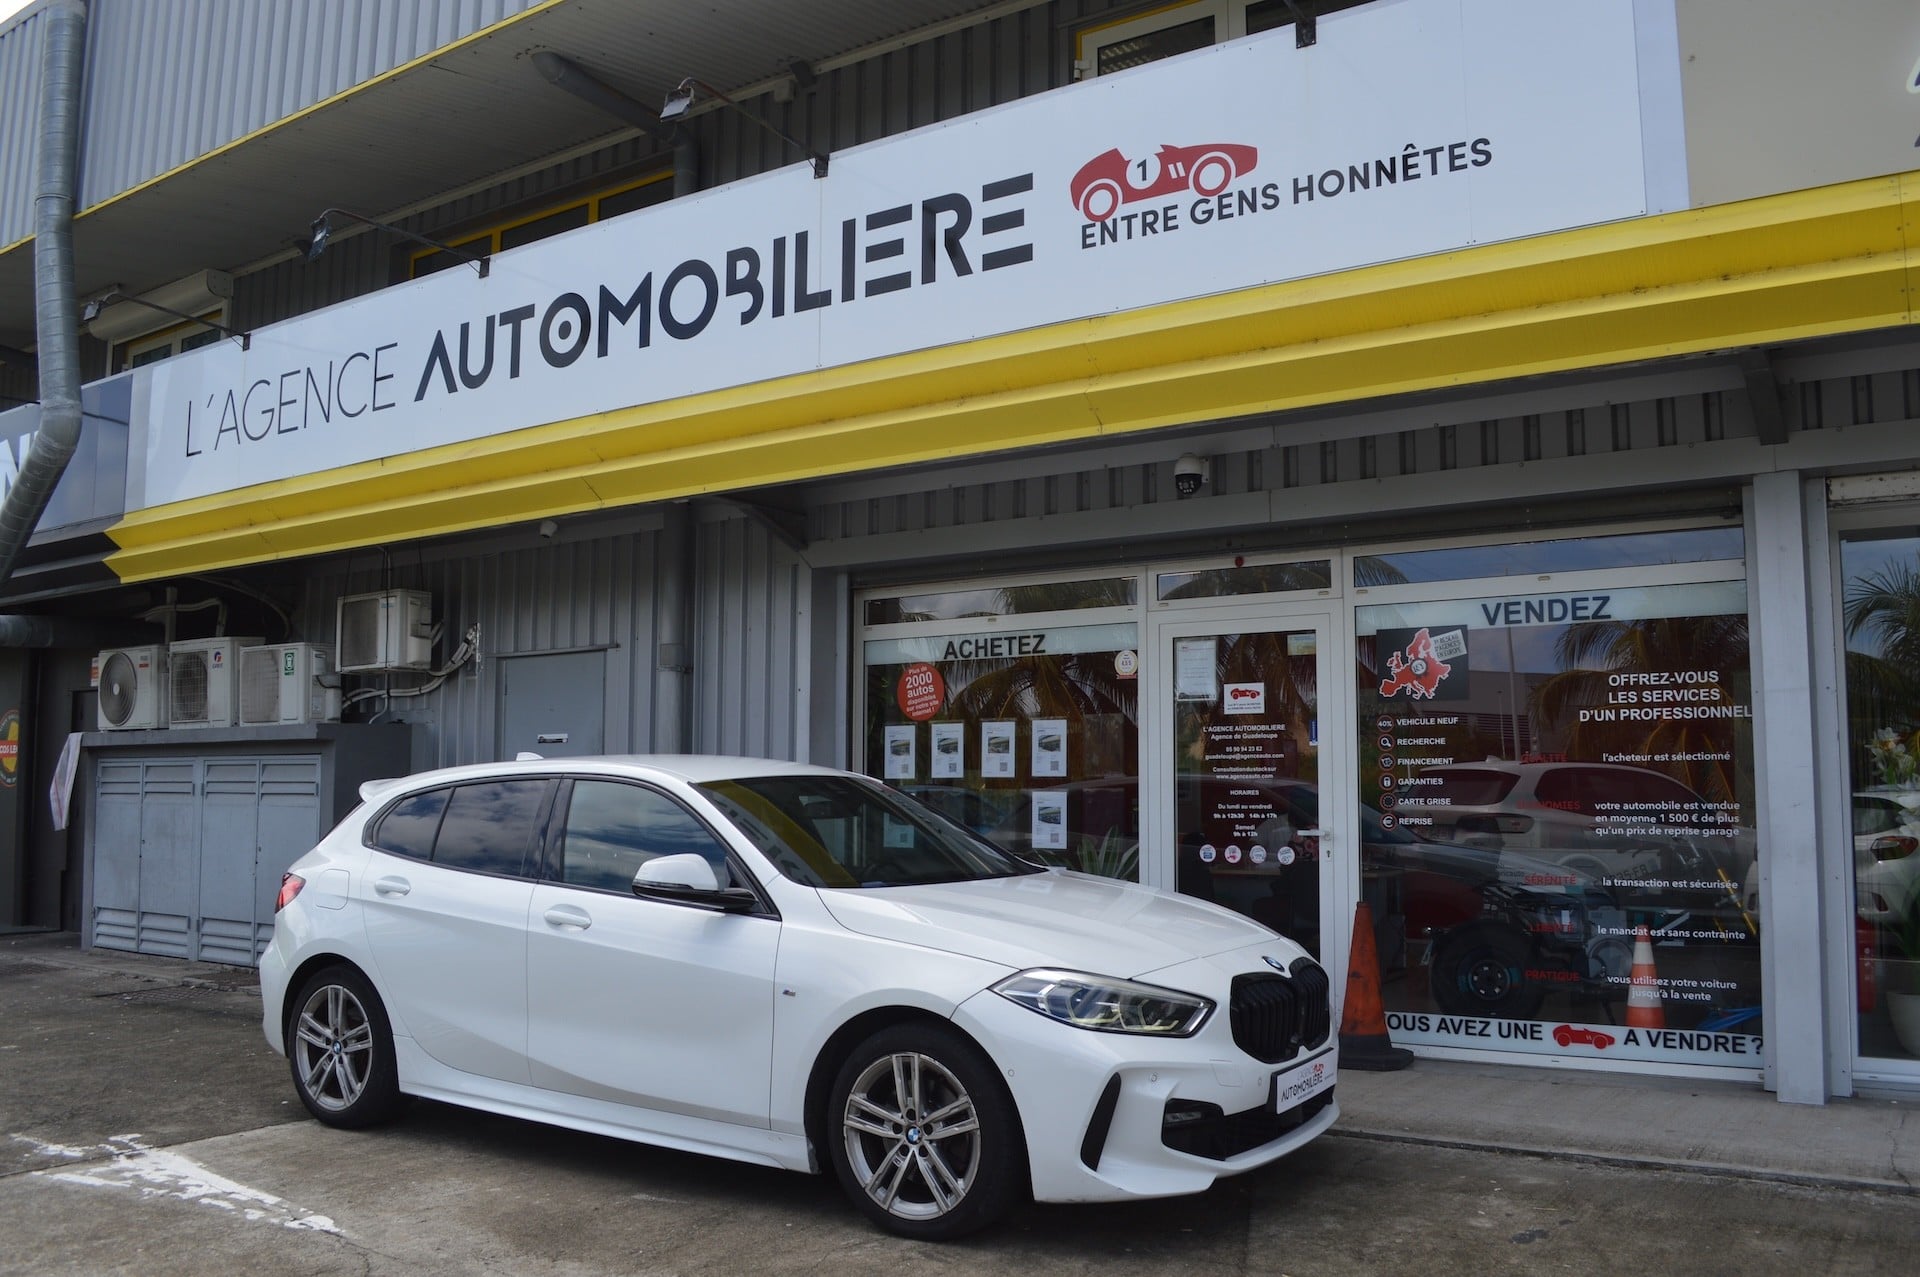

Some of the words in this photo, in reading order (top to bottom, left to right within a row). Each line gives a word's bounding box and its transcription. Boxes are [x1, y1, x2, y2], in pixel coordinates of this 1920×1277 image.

[1081, 204, 1179, 250] ENTRE
[1193, 182, 1279, 226] GENS
[1293, 138, 1492, 206] HONNÊTES
[186, 342, 398, 458] L'AGENCE
[414, 172, 1034, 402] AUTOMOBILIERE
[1480, 596, 1612, 626] VENDEZ
[944, 634, 1046, 660] ACHETEZ
[906, 672, 932, 689] 2000
[1608, 671, 1719, 686] OFFREZ-VOUS
[907, 684, 934, 698] autos
[1608, 691, 1638, 704] LES
[1642, 688, 1720, 703] SERVICES
[907, 694, 936, 705] disponibles
[1580, 710, 1615, 722] D'UN
[1620, 706, 1752, 720] PROFESSIONNEL
[1603, 753, 1652, 762] l'acheteur
[1672, 752, 1730, 762] sélectionné
[1623, 801, 1680, 810] automobile
[1701, 801, 1740, 810] vendue
[1610, 816, 1656, 825] moyenne
[1660, 814, 1664, 822] 1
[1669, 814, 1689, 823] 500
[1692, 814, 1699, 822] €
[1701, 814, 1714, 823] de
[1718, 814, 1740, 824] plus
[1596, 827, 1624, 836] qu'un
[1626, 826, 1646, 836] prix
[1648, 827, 1661, 835] de
[1664, 827, 1700, 837] reprise
[1702, 829, 1740, 837] garage
[1524, 873, 1577, 886] SÉRÉNITÉ
[1603, 878, 1612, 886] la
[1614, 878, 1669, 888] transaction
[1690, 879, 1738, 889] sécurisée
[1598, 926, 1606, 934] le
[1609, 927, 1648, 936] mandat
[1650, 928, 1665, 937] est
[1693, 930, 1746, 940] contrainte
[1634, 977, 1668, 986] utilisez
[1671, 979, 1698, 988] votre
[1700, 980, 1737, 989] voiture
[1632, 989, 1668, 1000] jusqu'à
[1670, 990, 1680, 999] la
[1682, 992, 1711, 1001] vente
[1384, 1014, 1430, 1032] OUS
[1436, 1018, 1492, 1037] AVEZ
[1498, 1023, 1543, 1041] UNE
[1624, 1029, 1640, 1046] A
[1646, 1031, 1746, 1055] VENDRE
[1752, 1037, 1763, 1055] ?
